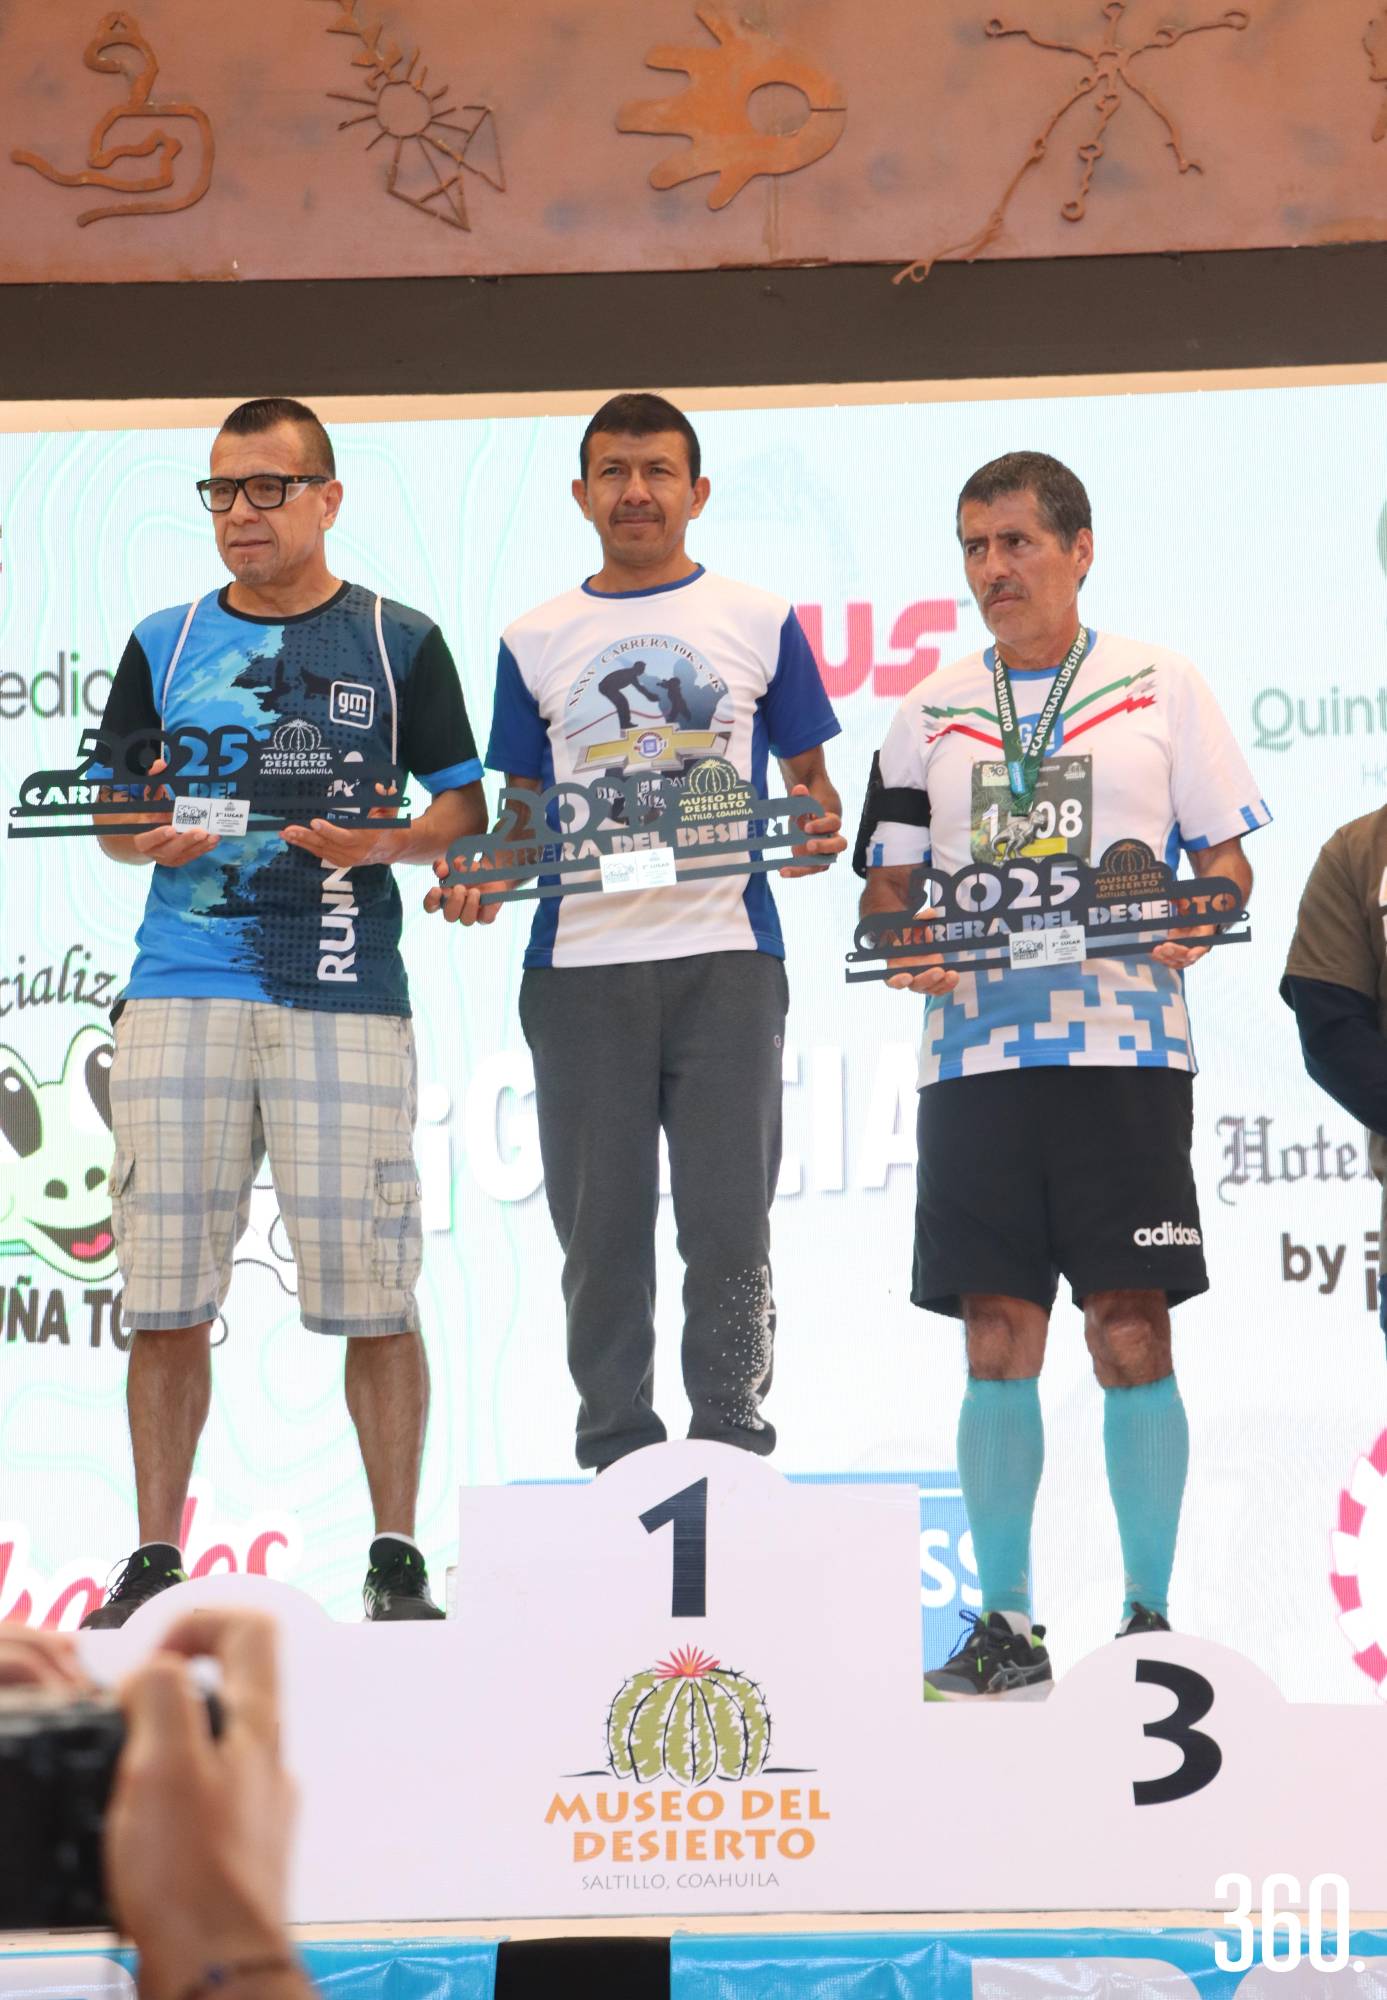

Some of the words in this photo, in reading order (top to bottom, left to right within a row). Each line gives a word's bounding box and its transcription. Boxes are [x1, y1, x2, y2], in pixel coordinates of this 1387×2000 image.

[600, 638, 669, 664] CARRERA
[996, 682, 1014, 732] DESIERTO
[260, 752, 307, 761] MUSEO
[309, 752, 333, 761] DEL
[265, 760, 327, 768] DESIERTO
[259, 768, 294, 776] SALTILLO,
[678, 795, 723, 808] MUSEO
[724, 791, 752, 802] DEL
[683, 800, 747, 814] DESIERTO
[680, 813, 715, 822] SALTILLO,
[716, 807, 754, 819] COAHUILA
[982, 798, 1083, 843] 108
[611, 830, 667, 854] DEL
[912, 861, 1081, 920] 2025
[1094, 874, 1140, 885] MUSEO
[1141, 872, 1164, 881] DEL
[1099, 879, 1159, 892] DESIERTO
[1022, 907, 1079, 932] DEL
[1087, 892, 1237, 926] DESIERTO
[1133, 1222, 1201, 1246] adidas
[1281, 1232, 1347, 1295] by
[638, 1476, 709, 1617] 1
[1132, 1658, 1223, 1806] 3
[543, 1790, 725, 1825] MUSEO
[741, 1788, 831, 1821] DEL
[572, 1827, 816, 1863] DESIERTO
[581, 1873, 671, 1892] SALTILLO,
[675, 1872, 780, 1890] COAHUILA
